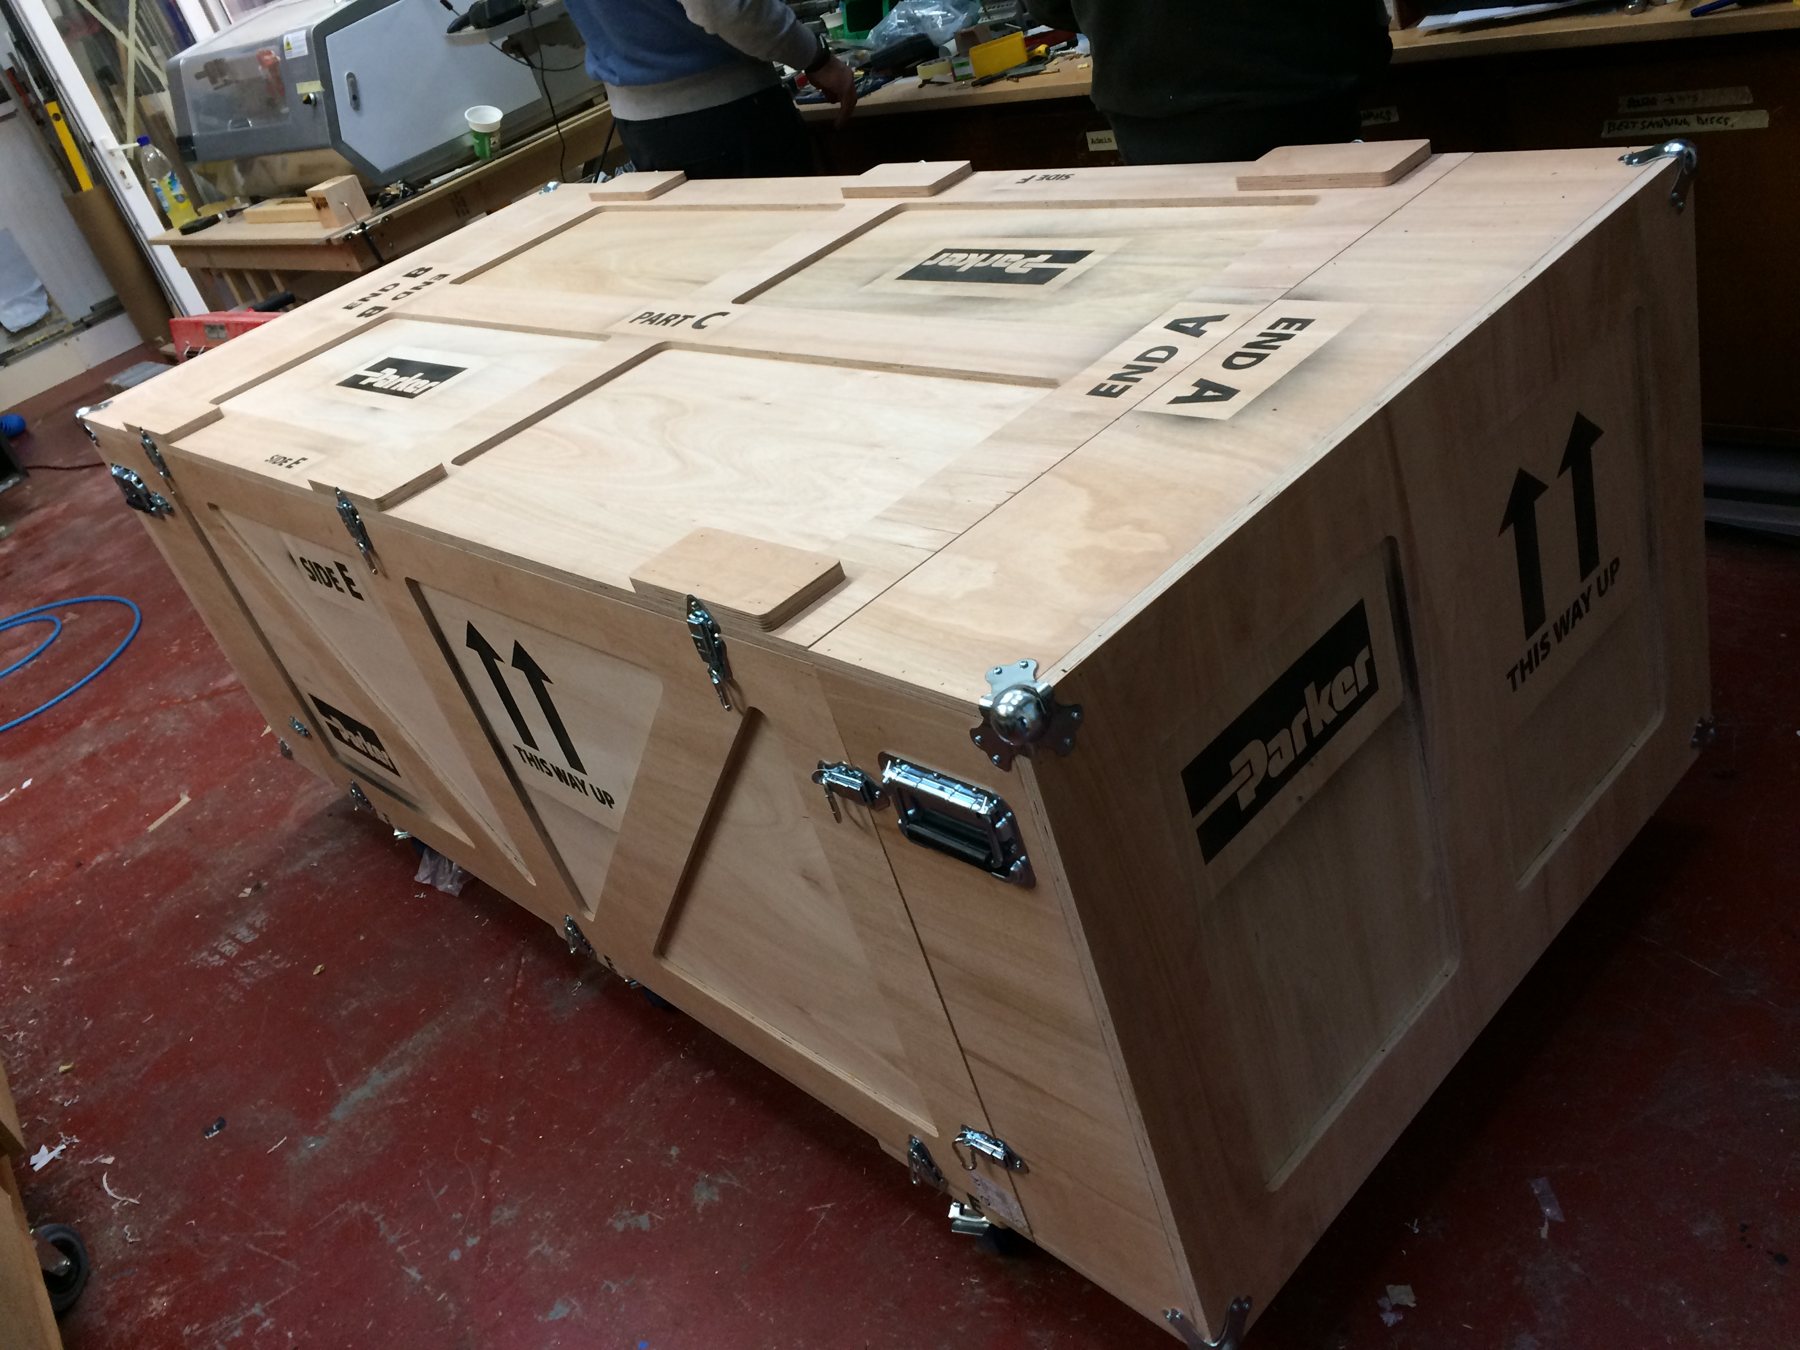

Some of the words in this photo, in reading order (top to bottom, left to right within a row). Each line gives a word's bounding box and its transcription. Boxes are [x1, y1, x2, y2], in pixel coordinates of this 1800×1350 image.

[1015, 174, 1037, 184] F
[1036, 173, 1075, 182] SIDE
[921, 252, 1058, 274] Parker
[342, 283, 401, 310] END
[402, 266, 433, 278] B
[391, 273, 450, 301] END
[356, 305, 389, 318] B
[629, 311, 696, 328] PART
[691, 311, 731, 330] C
[1085, 345, 1179, 398] END
[1163, 313, 1231, 338] A
[1222, 317, 1316, 370] END
[352, 366, 442, 395] Parker
[1166, 377, 1241, 405] A
[264, 454, 293, 467] SIDE
[285, 457, 309, 469] E
[299, 556, 345, 594] SIDE
[333, 560, 365, 601] E
[1506, 631, 1550, 693] THIS
[1552, 584, 1592, 643] WAY
[1597, 556, 1620, 598] UP
[324, 714, 396, 771] Parker
[1212, 644, 1372, 816] Parker
[512, 744, 554, 778] THIS
[549, 762, 589, 797] WAY
[589, 783, 615, 809] UP
